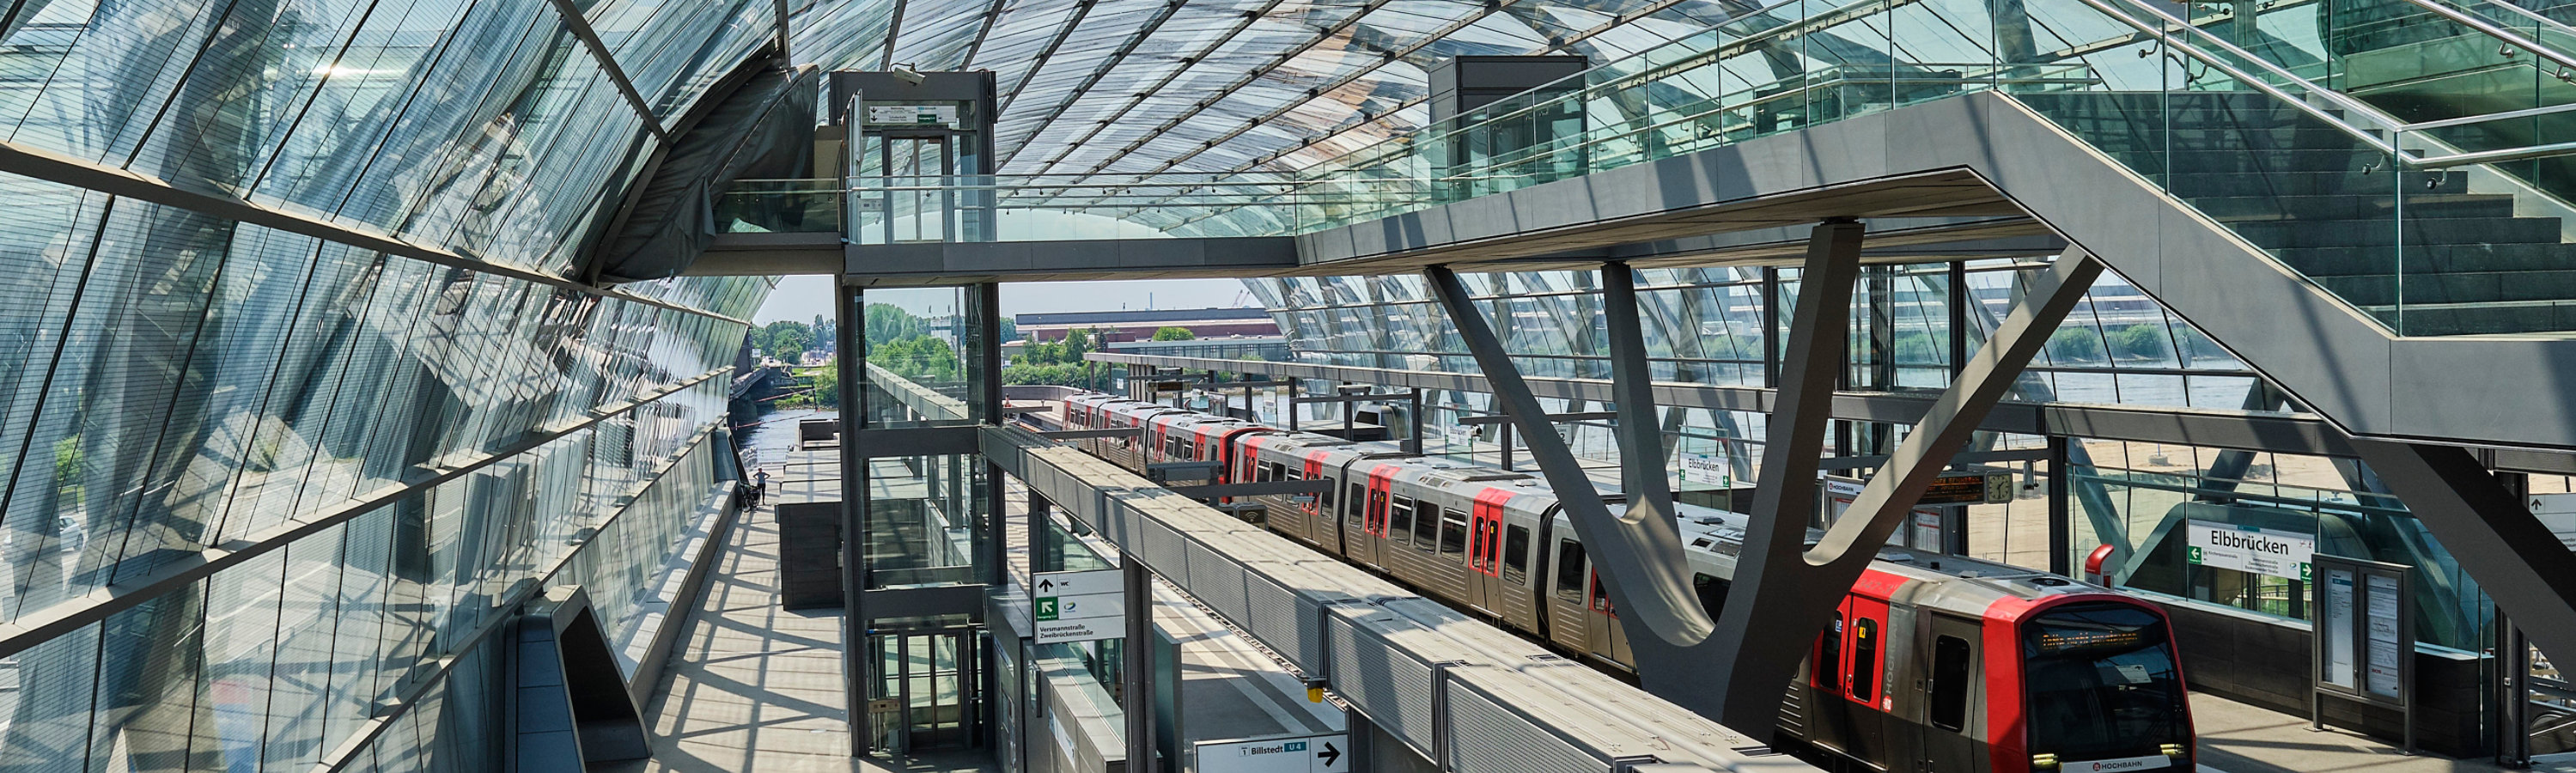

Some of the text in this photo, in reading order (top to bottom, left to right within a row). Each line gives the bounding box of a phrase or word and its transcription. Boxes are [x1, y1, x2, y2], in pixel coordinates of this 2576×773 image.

[2211, 530, 2289, 555] Elbbrücken
[1039, 624, 1085, 633] Versmannstraße
[1039, 630, 1093, 639] Zweibrückenstraße
[1251, 745, 1283, 755] Billstedt
[2101, 761, 2142, 770] HOCHBAHN
